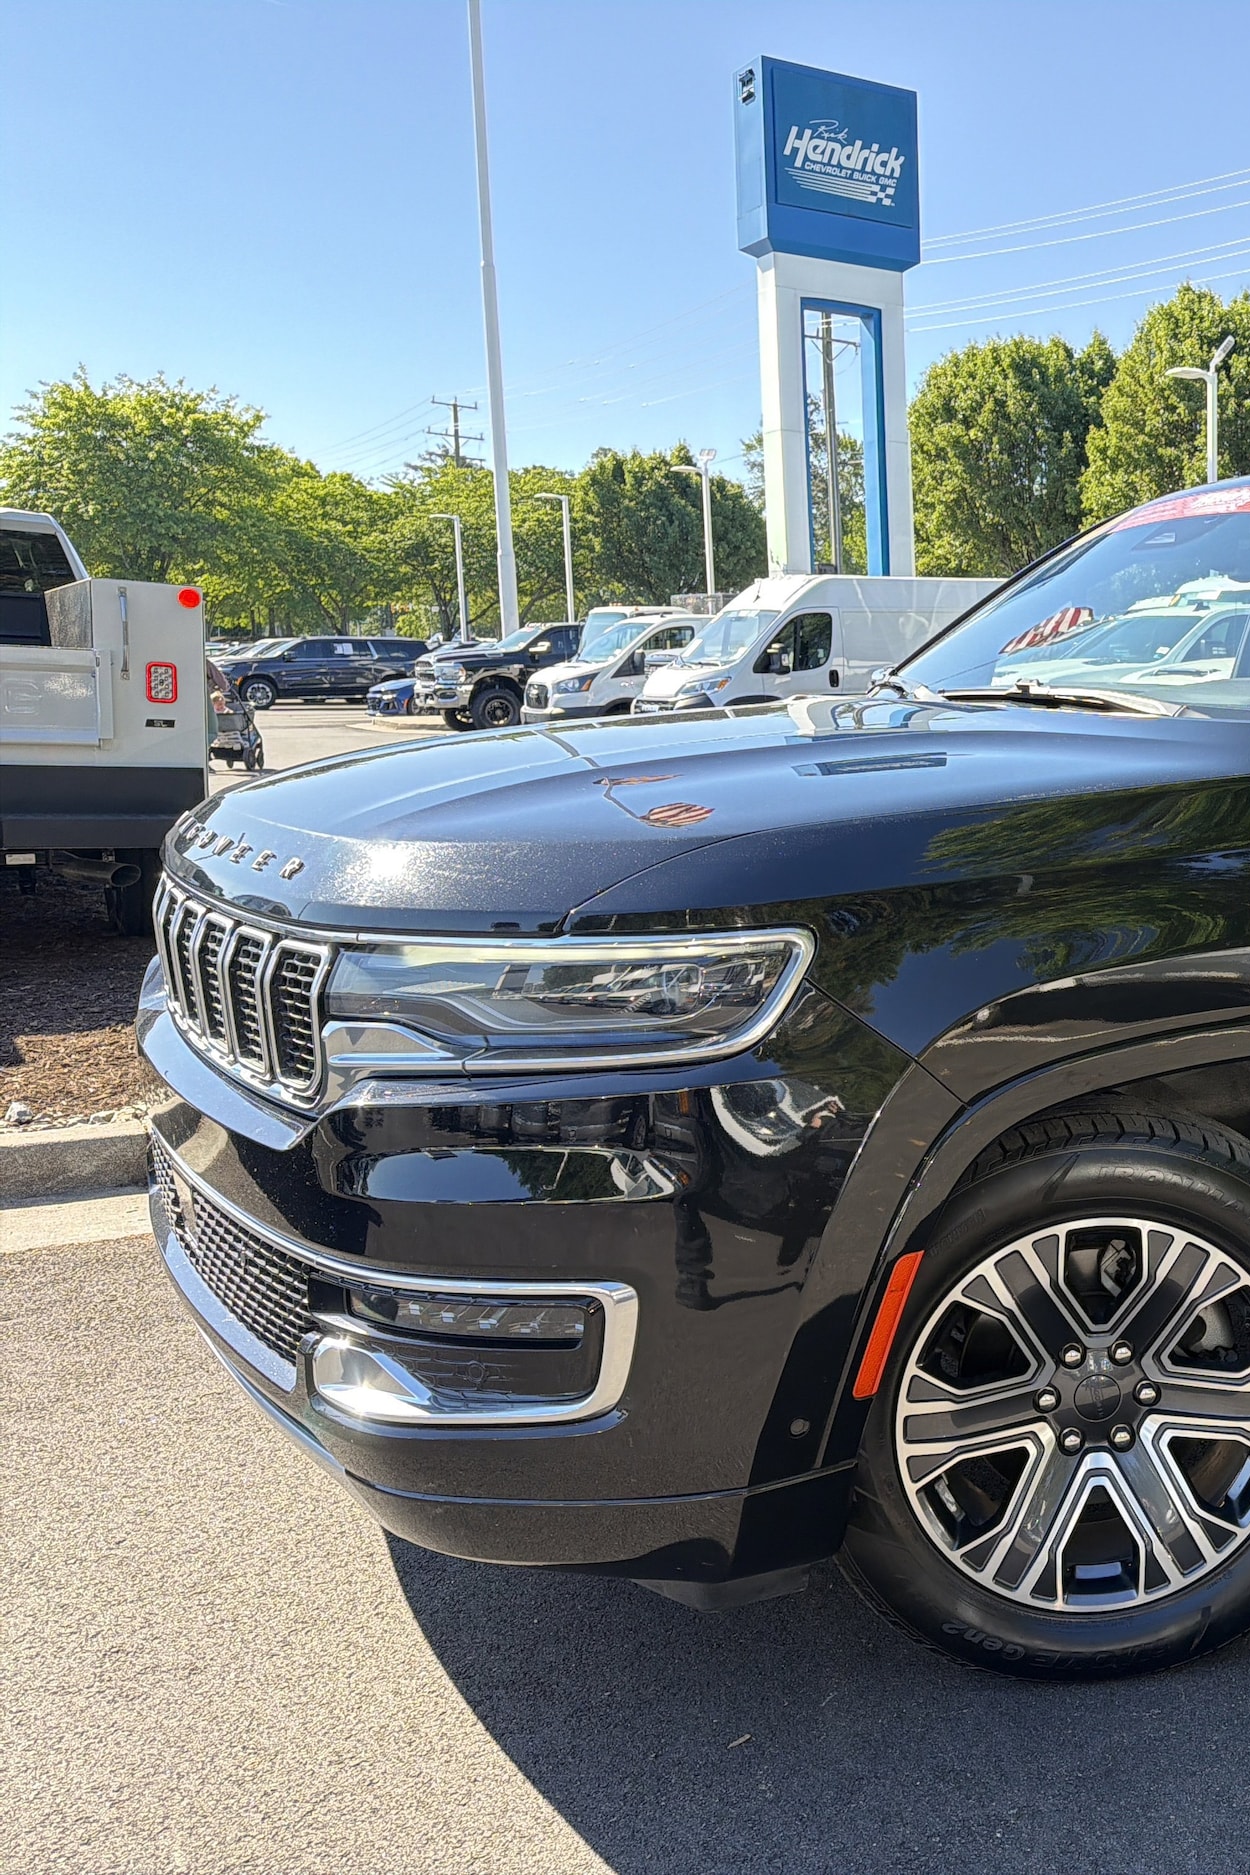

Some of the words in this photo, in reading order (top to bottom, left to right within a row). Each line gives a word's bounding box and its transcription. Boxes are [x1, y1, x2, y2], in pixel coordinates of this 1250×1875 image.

[783, 125, 905, 178] Hendrick
[804, 161, 852, 177] CHEVROLET
[852, 171, 876, 183] BUICK
[878, 177, 898, 187] GMC
